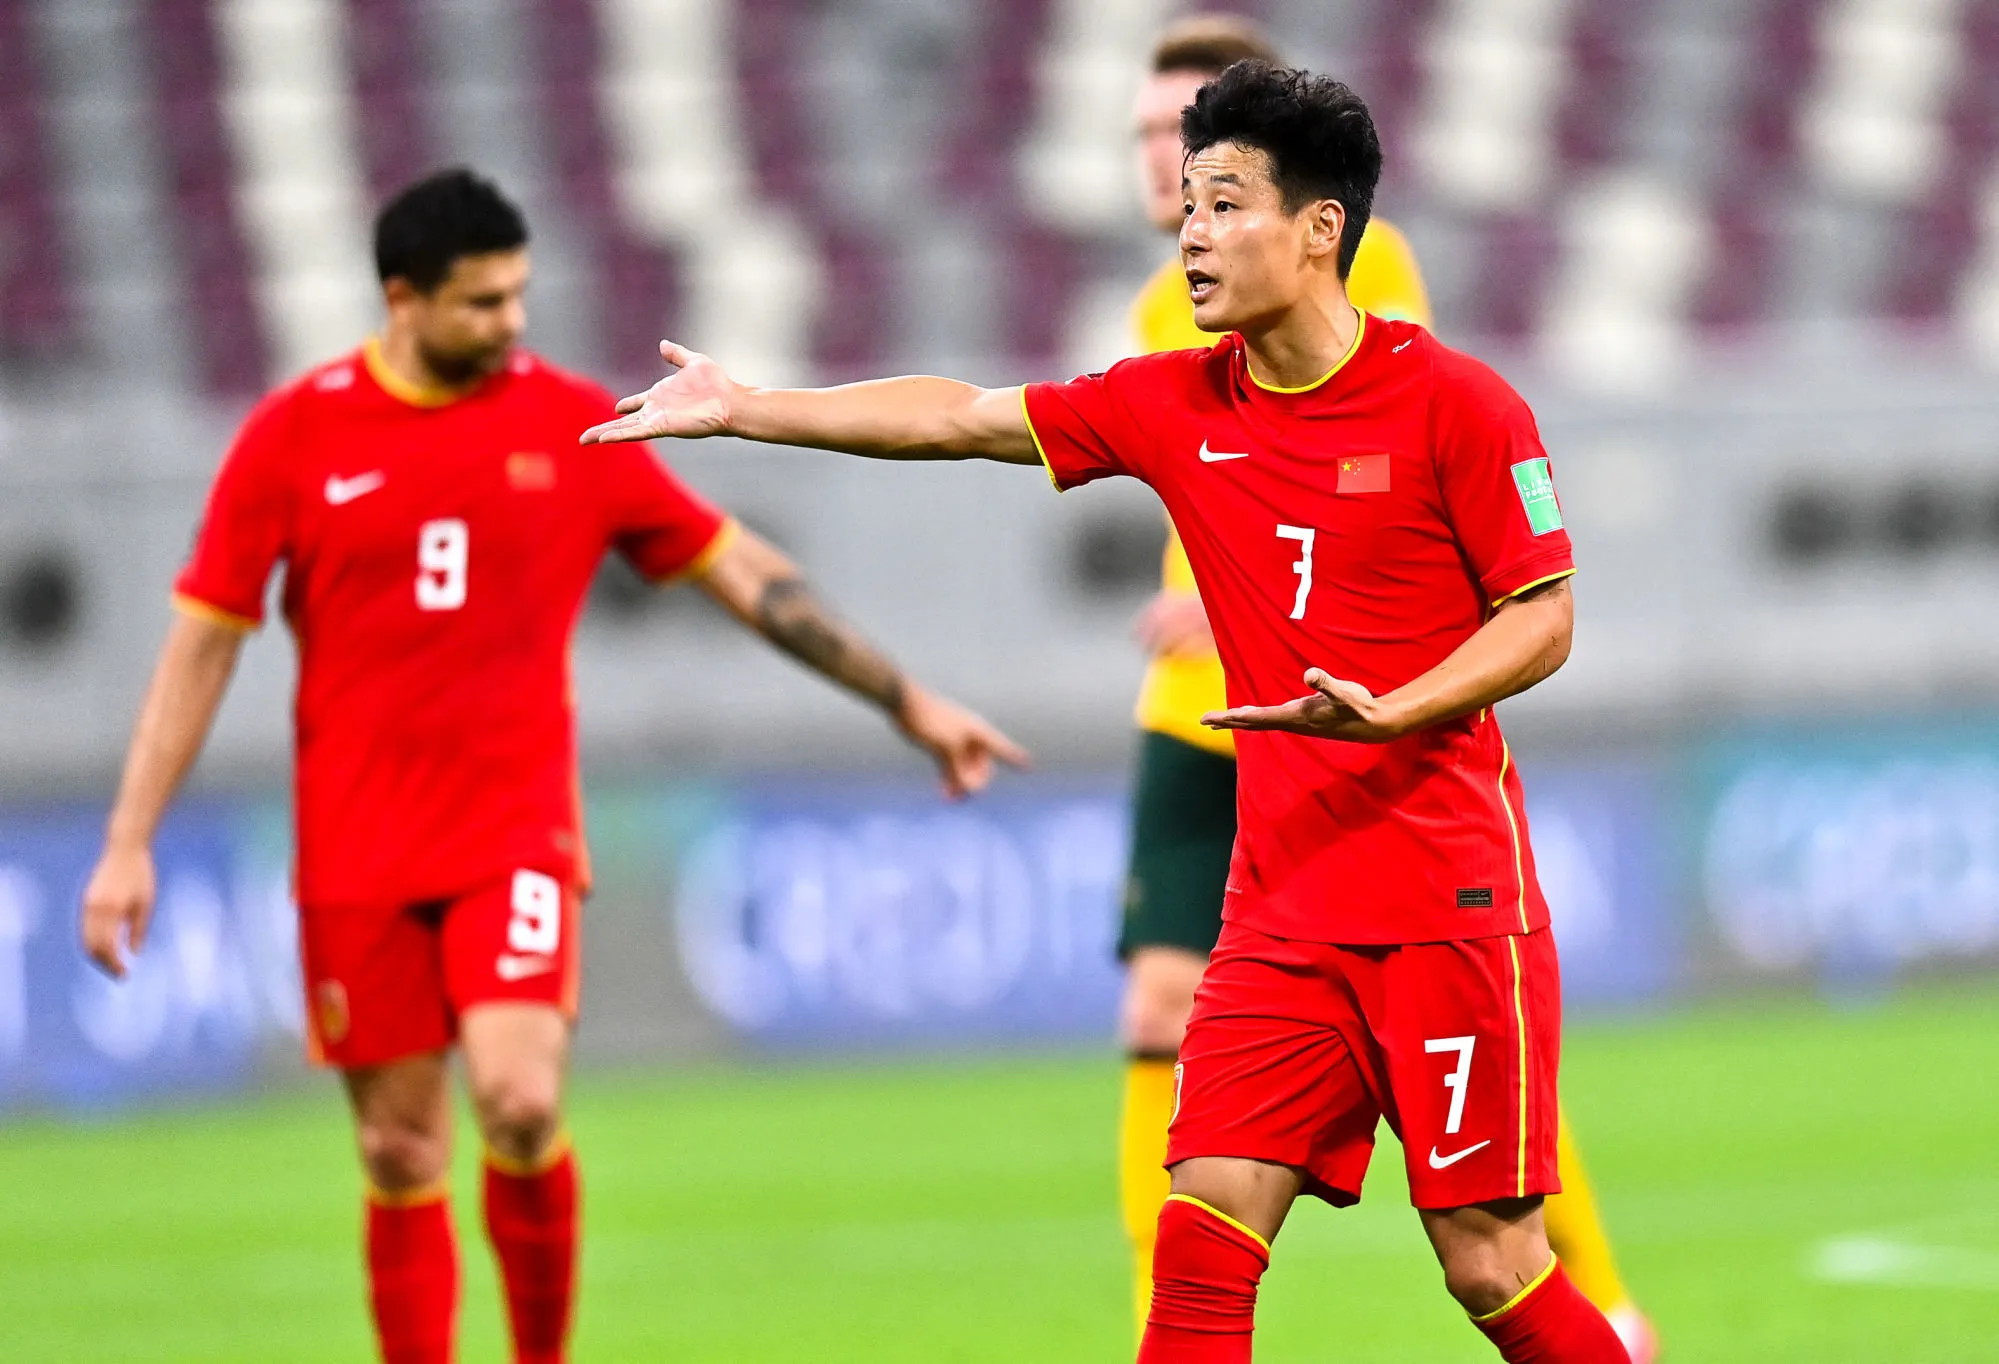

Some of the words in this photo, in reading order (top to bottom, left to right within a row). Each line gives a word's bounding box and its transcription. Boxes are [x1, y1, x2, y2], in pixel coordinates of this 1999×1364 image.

[415, 519, 469, 610] 9
[1276, 524, 1315, 620] 7
[508, 868, 561, 953] 9
[1425, 1036, 1476, 1134] 7
